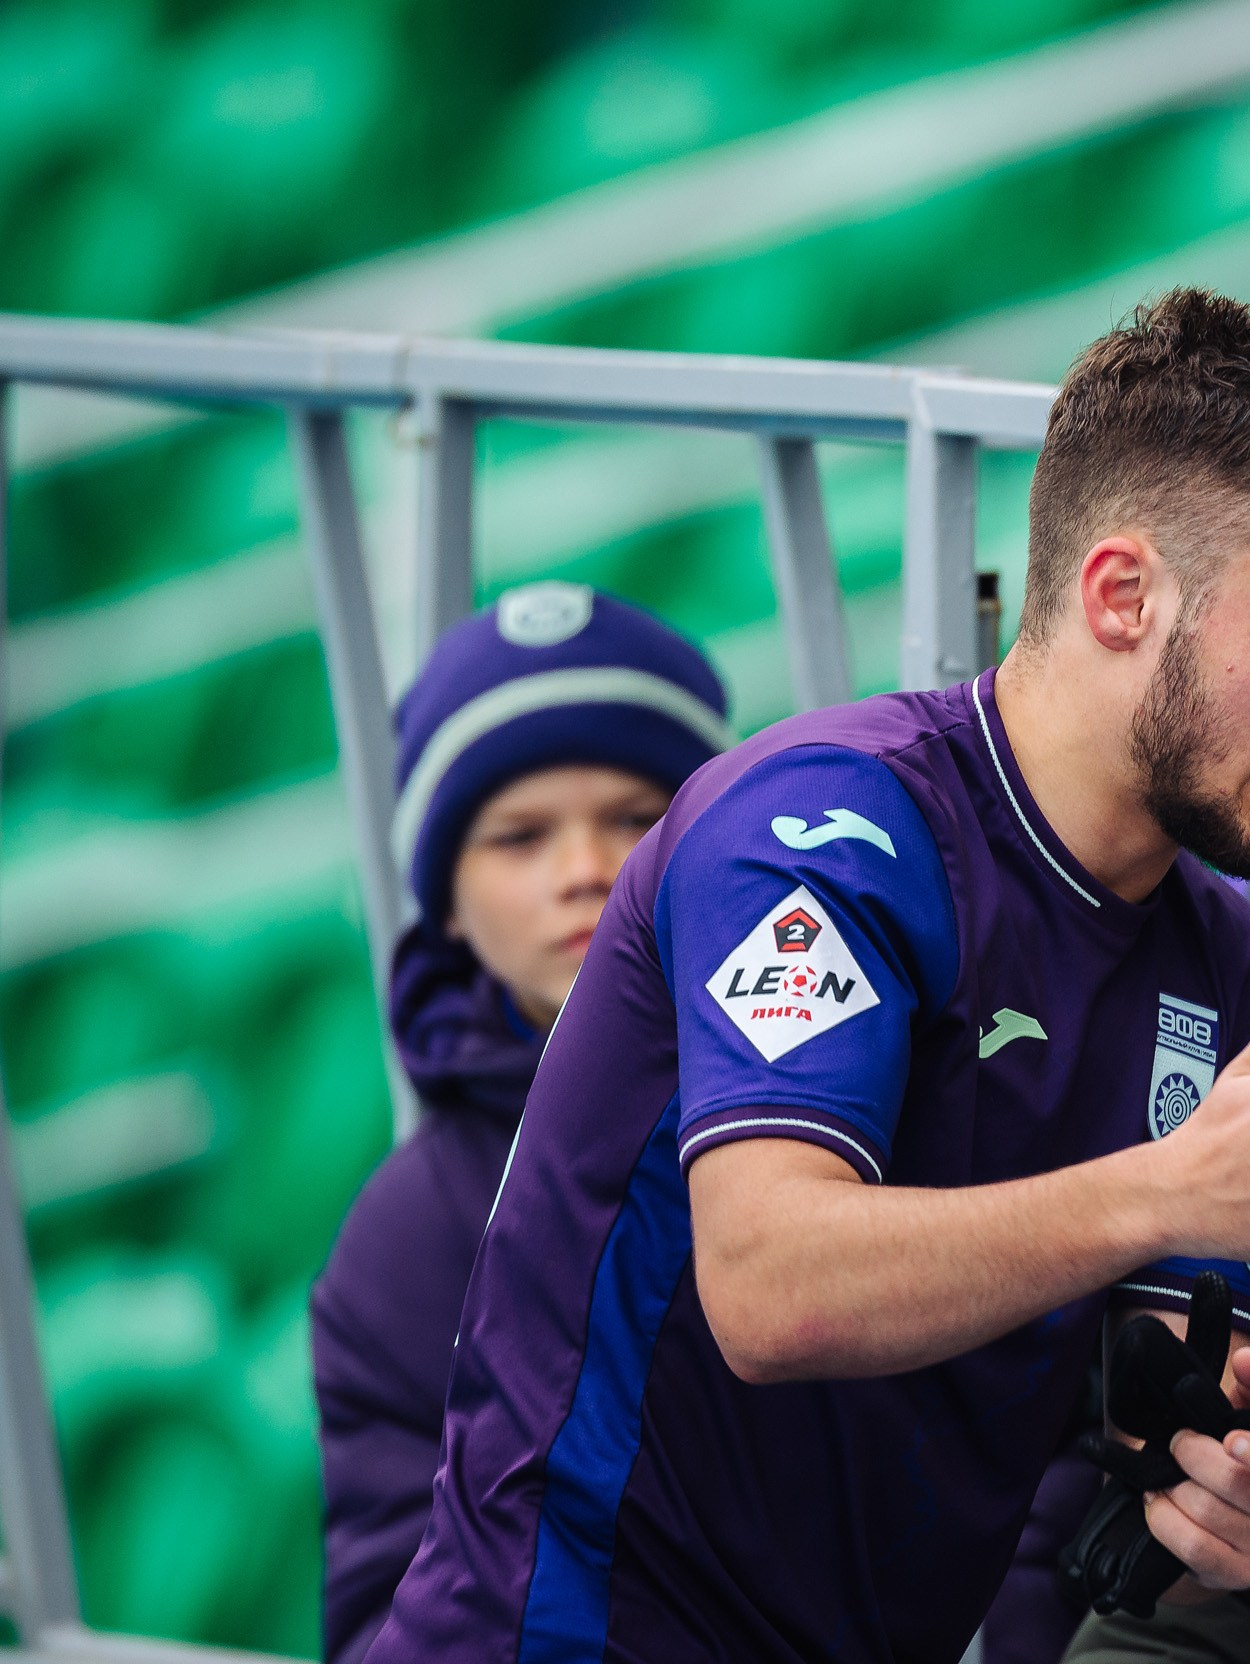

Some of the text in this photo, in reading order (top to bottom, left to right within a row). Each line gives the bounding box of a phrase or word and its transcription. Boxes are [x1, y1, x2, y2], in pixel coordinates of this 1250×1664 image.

[786, 924, 806, 941] 2
[725, 965, 856, 1004] LEON
[751, 1006, 813, 1022] ЛИГА
